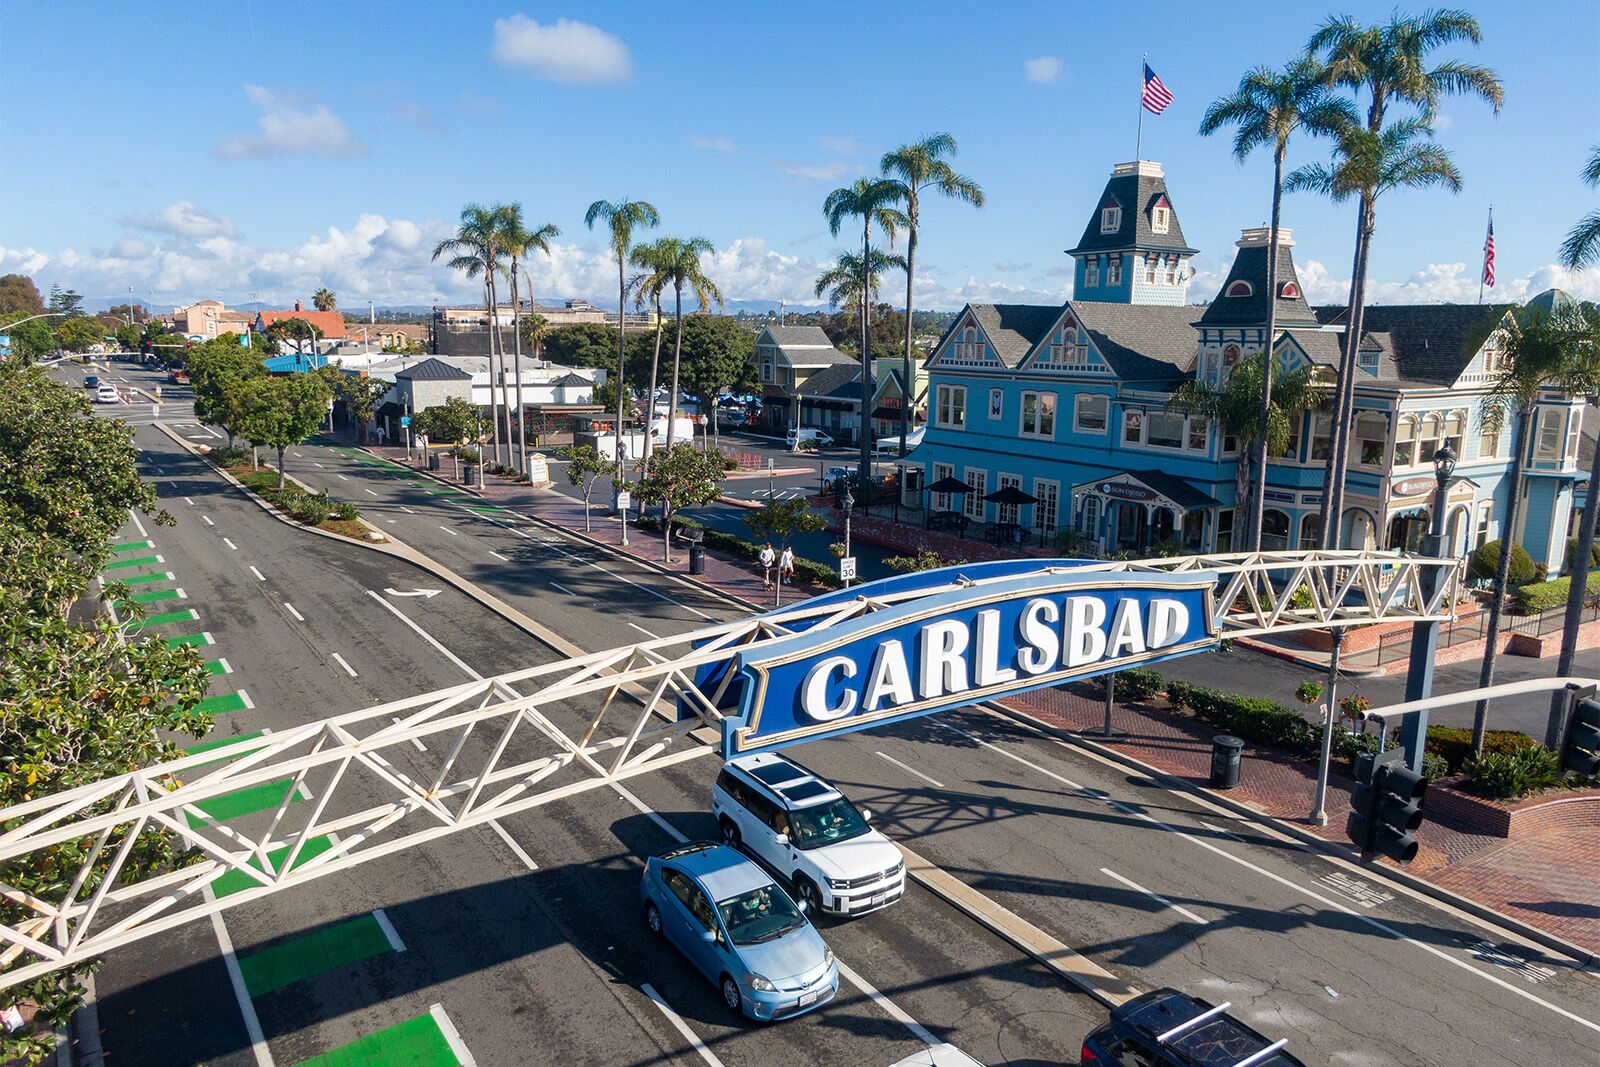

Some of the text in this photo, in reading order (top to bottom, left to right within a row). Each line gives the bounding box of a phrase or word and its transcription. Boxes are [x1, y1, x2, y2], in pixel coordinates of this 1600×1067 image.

[842, 568, 854, 577] 30
[801, 596, 1189, 721] CARLSBAD
[1310, 871, 1396, 908] LANE
